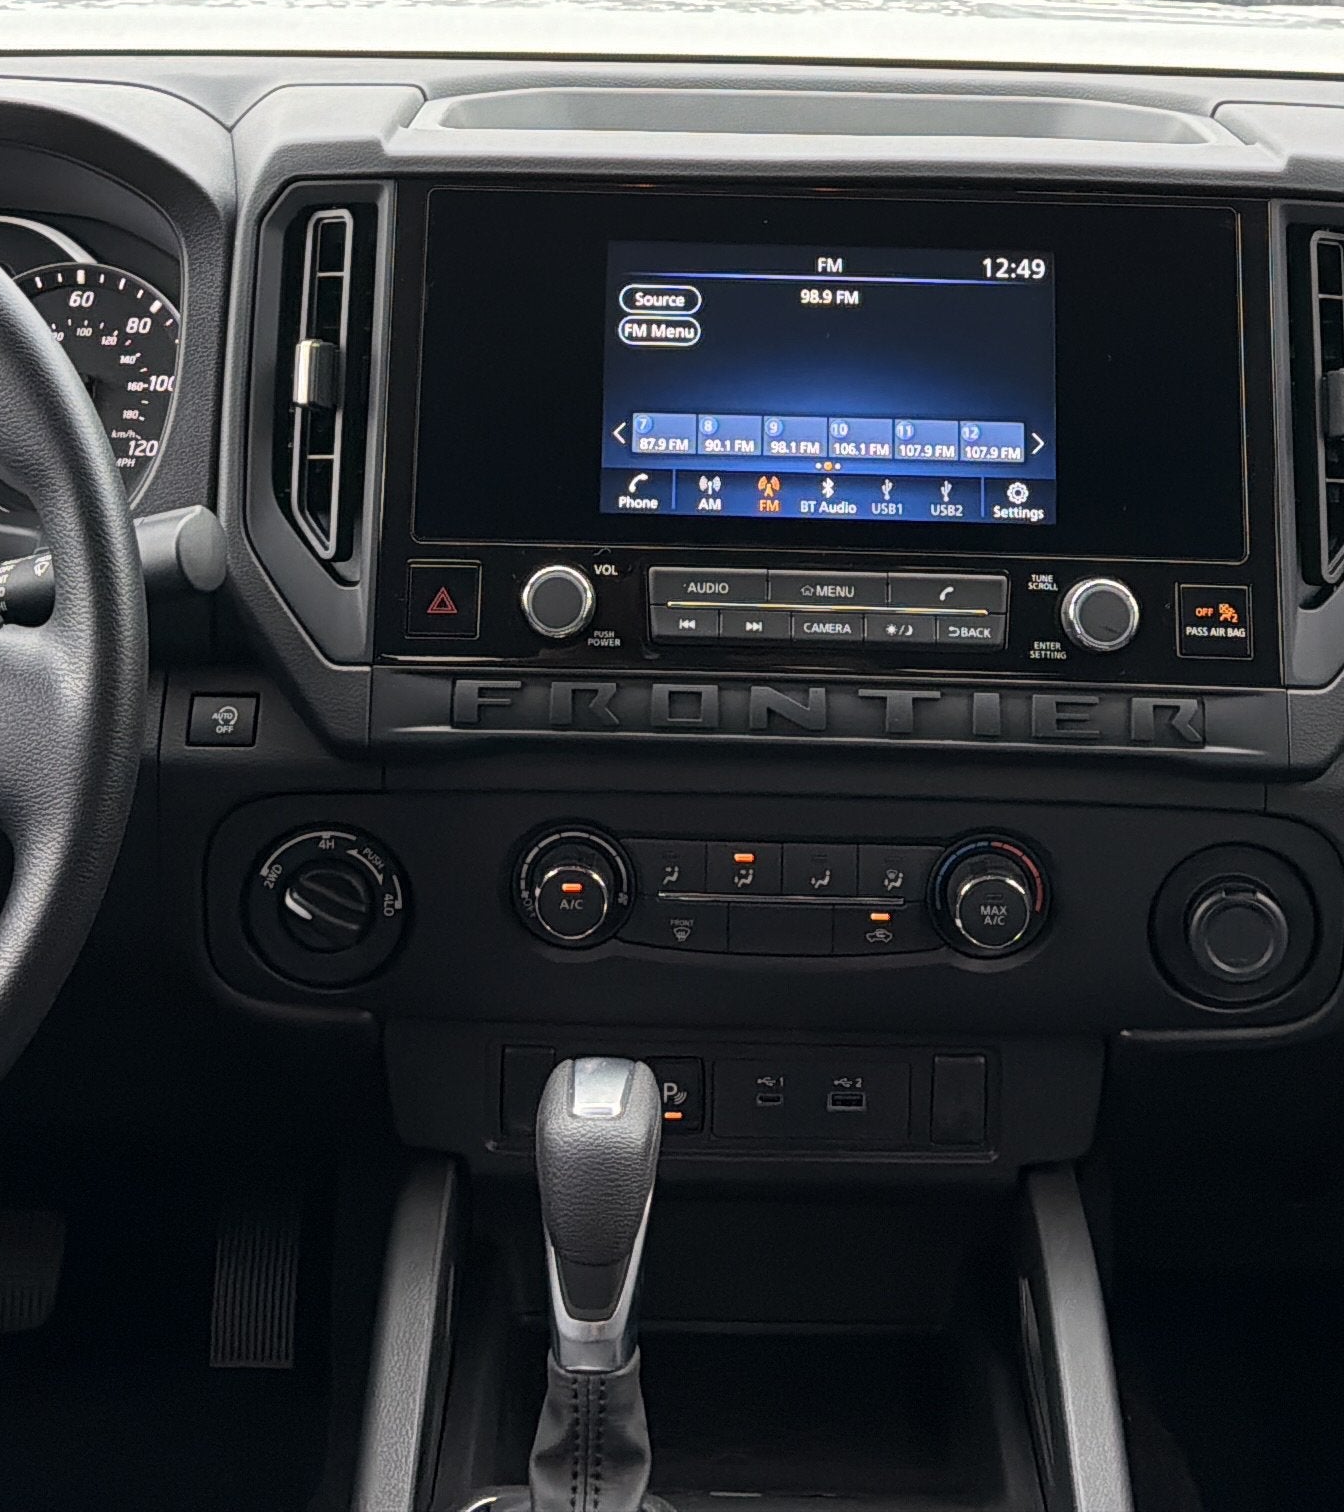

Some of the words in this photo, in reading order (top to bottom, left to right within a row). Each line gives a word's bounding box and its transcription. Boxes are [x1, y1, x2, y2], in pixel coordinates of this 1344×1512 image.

[817, 257, 843, 273] FM
[982, 258, 1046, 279] 12:49
[69, 291, 94, 307] 60
[635, 292, 685, 307] Source
[800, 289, 832, 304] 98.9
[836, 290, 859, 305] FM
[126, 318, 152, 333] 80
[624, 324, 646, 338] FM
[651, 324, 695, 339] Menu
[128, 440, 158, 456] 120
[639, 438, 667, 451] 87.9
[669, 439, 689, 451] FM
[705, 439, 730, 452] 90.1
[735, 440, 754, 453] FM
[770, 441, 796, 453] 98.1
[800, 442, 820, 454] FM
[833, 443, 865, 456] 106.1
[870, 444, 889, 456] FM
[899, 444, 932, 457] 107.9
[935, 445, 955, 458] FM
[965, 446, 998, 459] 107.9
[1001, 447, 1021, 460] FM
[619, 496, 658, 509] Phone
[698, 498, 721, 510] AM
[760, 500, 780, 512] FM
[800, 501, 816, 513] BT
[819, 501, 857, 514] Audio
[872, 503, 903, 515] USB1
[931, 504, 963, 517] USB2
[993, 505, 1044, 522] Settings
[593, 564, 618, 576] VOL
[1031, 574, 1054, 583] TUNE
[687, 582, 729, 594] AUDIO
[816, 585, 855, 598] MENU
[1027, 582, 1058, 591] SCROLL
[1195, 608, 1214, 617] OFF
[593, 630, 614, 638] PUSH
[803, 623, 851, 634] CAMERA
[961, 627, 991, 639] BACK
[1186, 627, 1209, 637] PASS
[1210, 627, 1226, 637] AIR
[1227, 628, 1246, 638] BAG
[588, 638, 621, 647] POWER
[1033, 642, 1061, 650] ENTER
[1029, 650, 1067, 660] SETTING
[453, 680, 1202, 743] FRONTIER
[318, 840, 335, 850] 4H
[363, 848, 385, 869] PUSH
[264, 864, 283, 889] 2WD
[383, 893, 395, 916] 4LO
[560, 899, 584, 910] A/C
[980, 905, 1007, 916] MAX
[984, 915, 1005, 925] A/C
